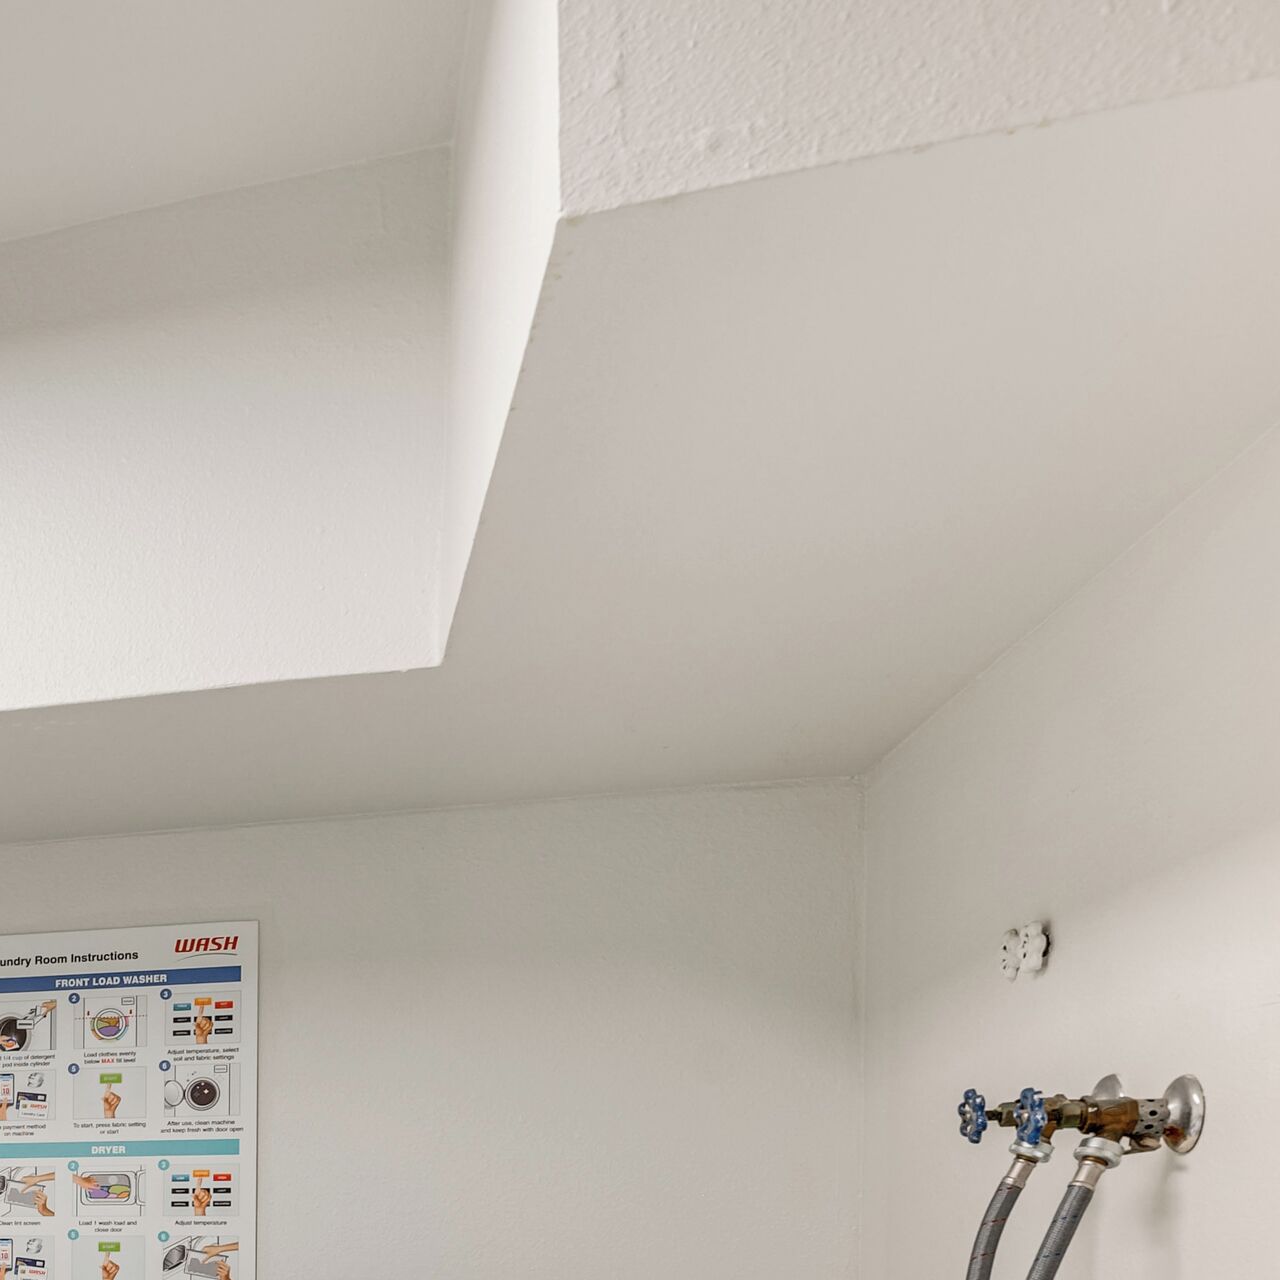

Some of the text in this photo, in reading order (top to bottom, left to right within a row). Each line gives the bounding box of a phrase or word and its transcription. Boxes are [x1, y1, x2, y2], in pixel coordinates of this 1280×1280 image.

[174, 936, 239, 953] WASH
[35, 955, 67, 965] Room
[71, 951, 139, 963] Instructions
[55, 974, 167, 988] FRONT LOAD WASHER
[91, 1146, 126, 1154] DRYER
